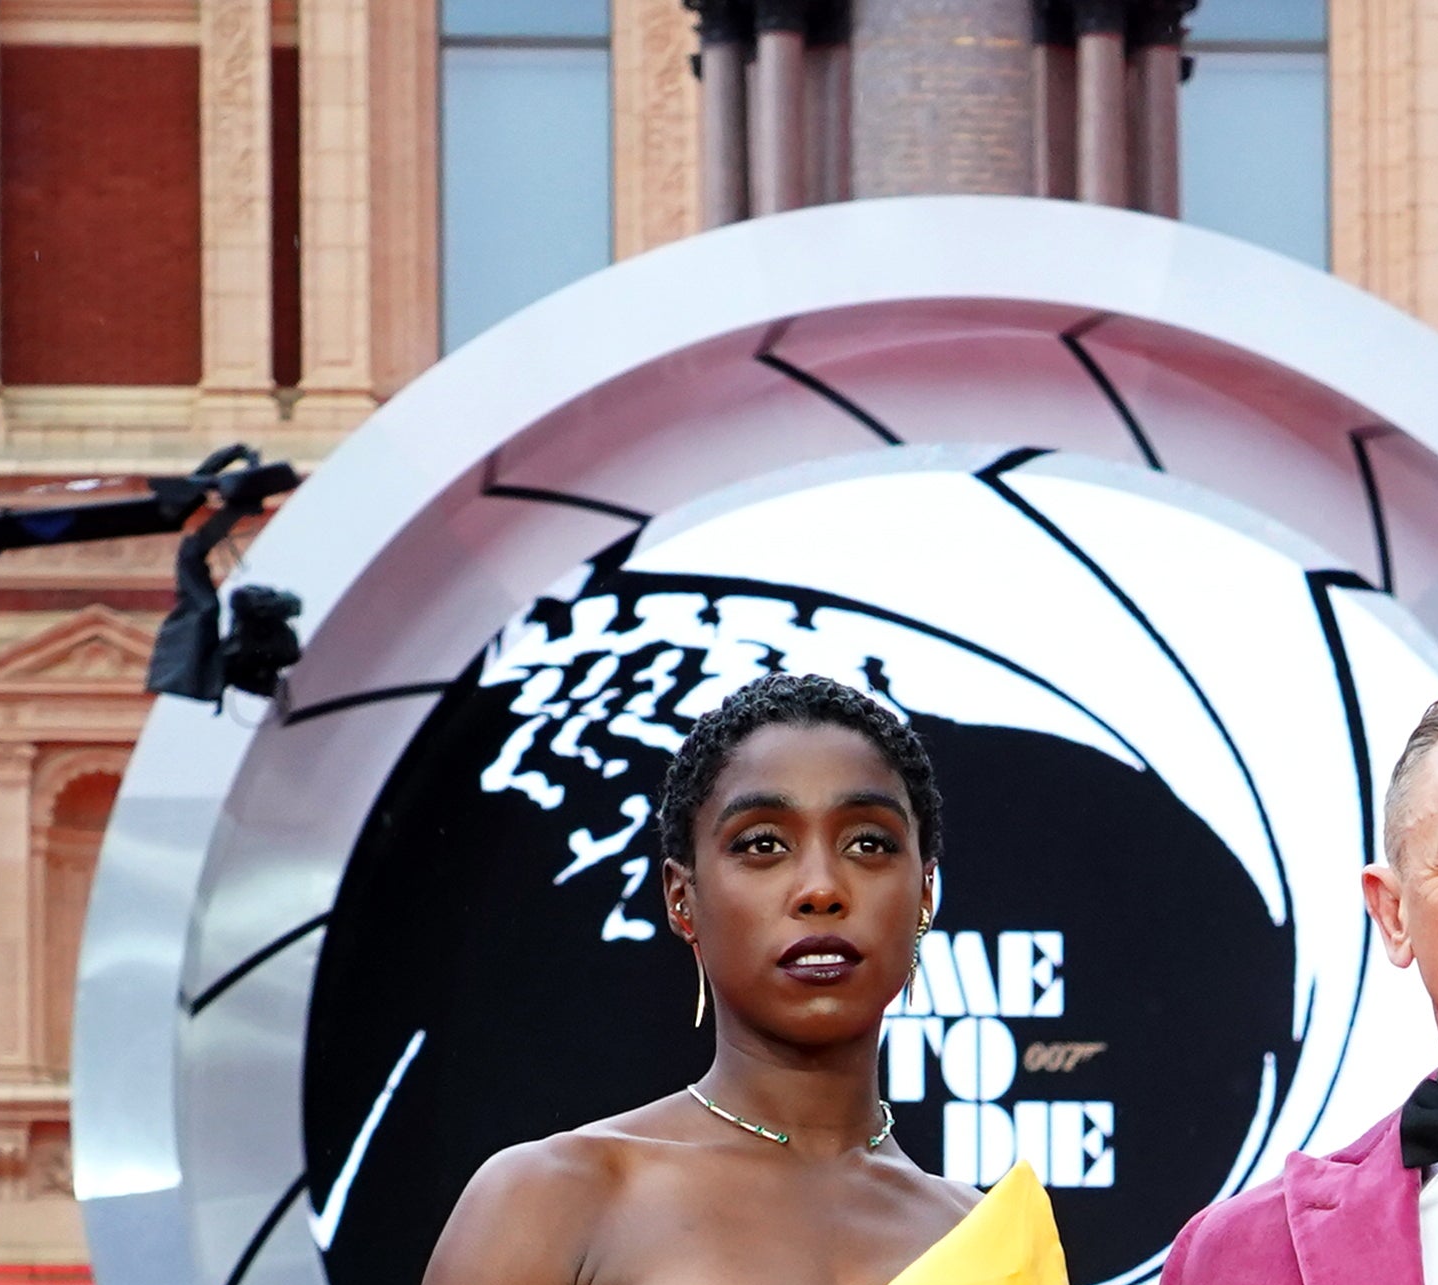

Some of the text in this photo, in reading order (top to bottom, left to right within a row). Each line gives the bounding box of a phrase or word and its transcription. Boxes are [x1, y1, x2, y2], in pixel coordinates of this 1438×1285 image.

[883, 930, 1065, 1017] ME
[878, 1016, 1017, 1102] TO
[1022, 1042, 1094, 1073] 007
[943, 1101, 1115, 1188] DIE
